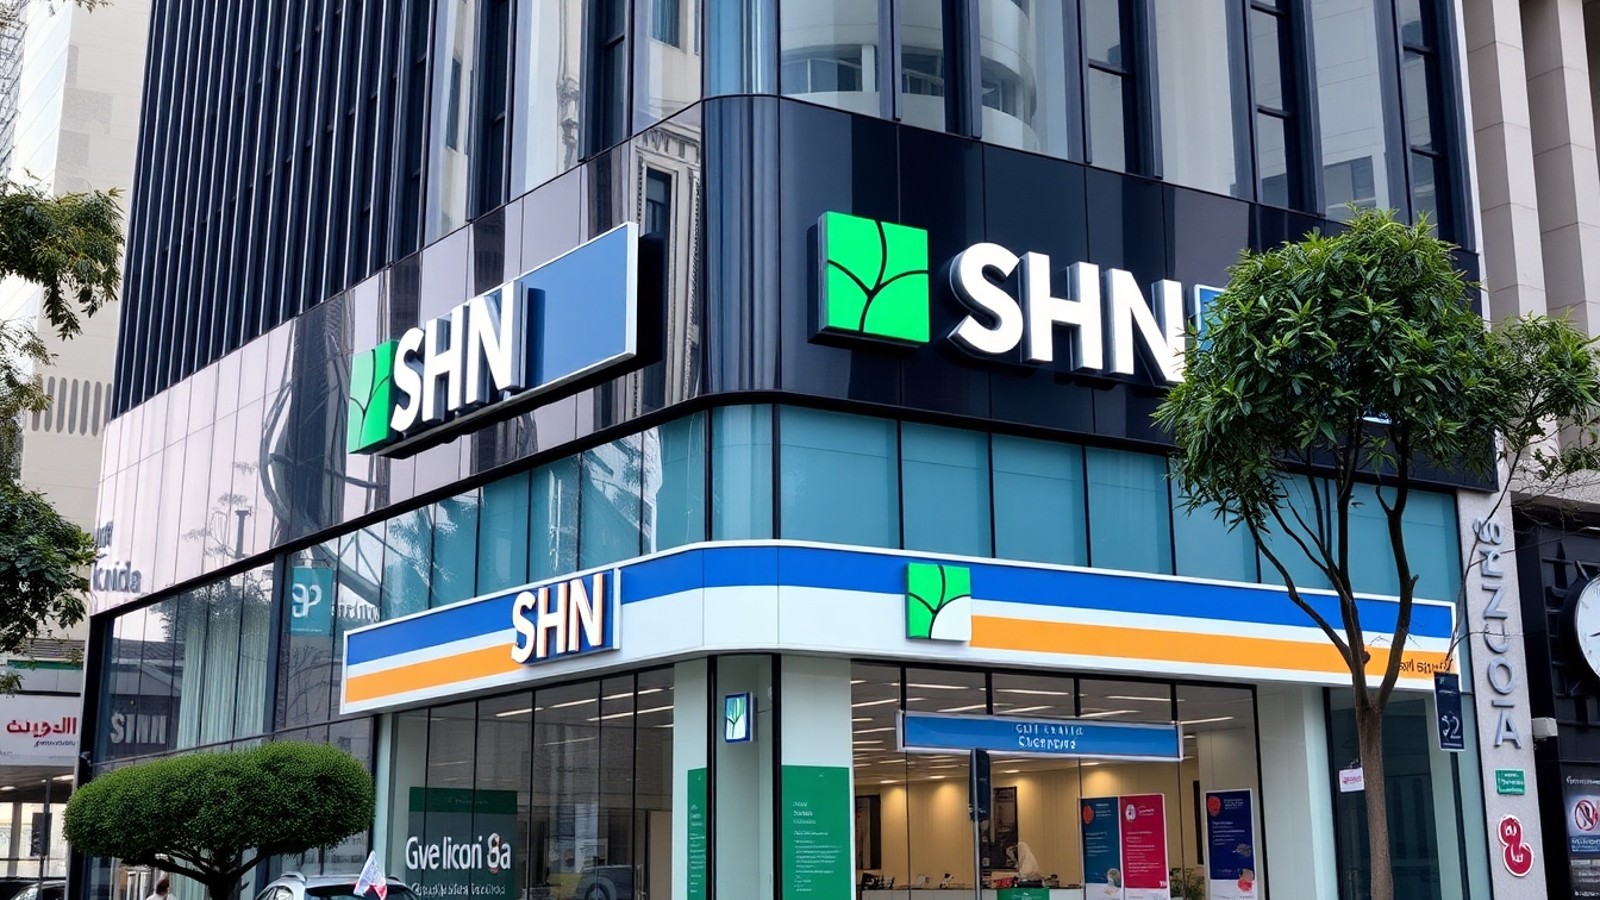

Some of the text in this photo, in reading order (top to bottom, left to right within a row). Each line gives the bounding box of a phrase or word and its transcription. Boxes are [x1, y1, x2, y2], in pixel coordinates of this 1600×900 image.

[390, 279, 523, 433] SHN
[947, 241, 1186, 383] SHN
[511, 573, 606, 664] SHN
